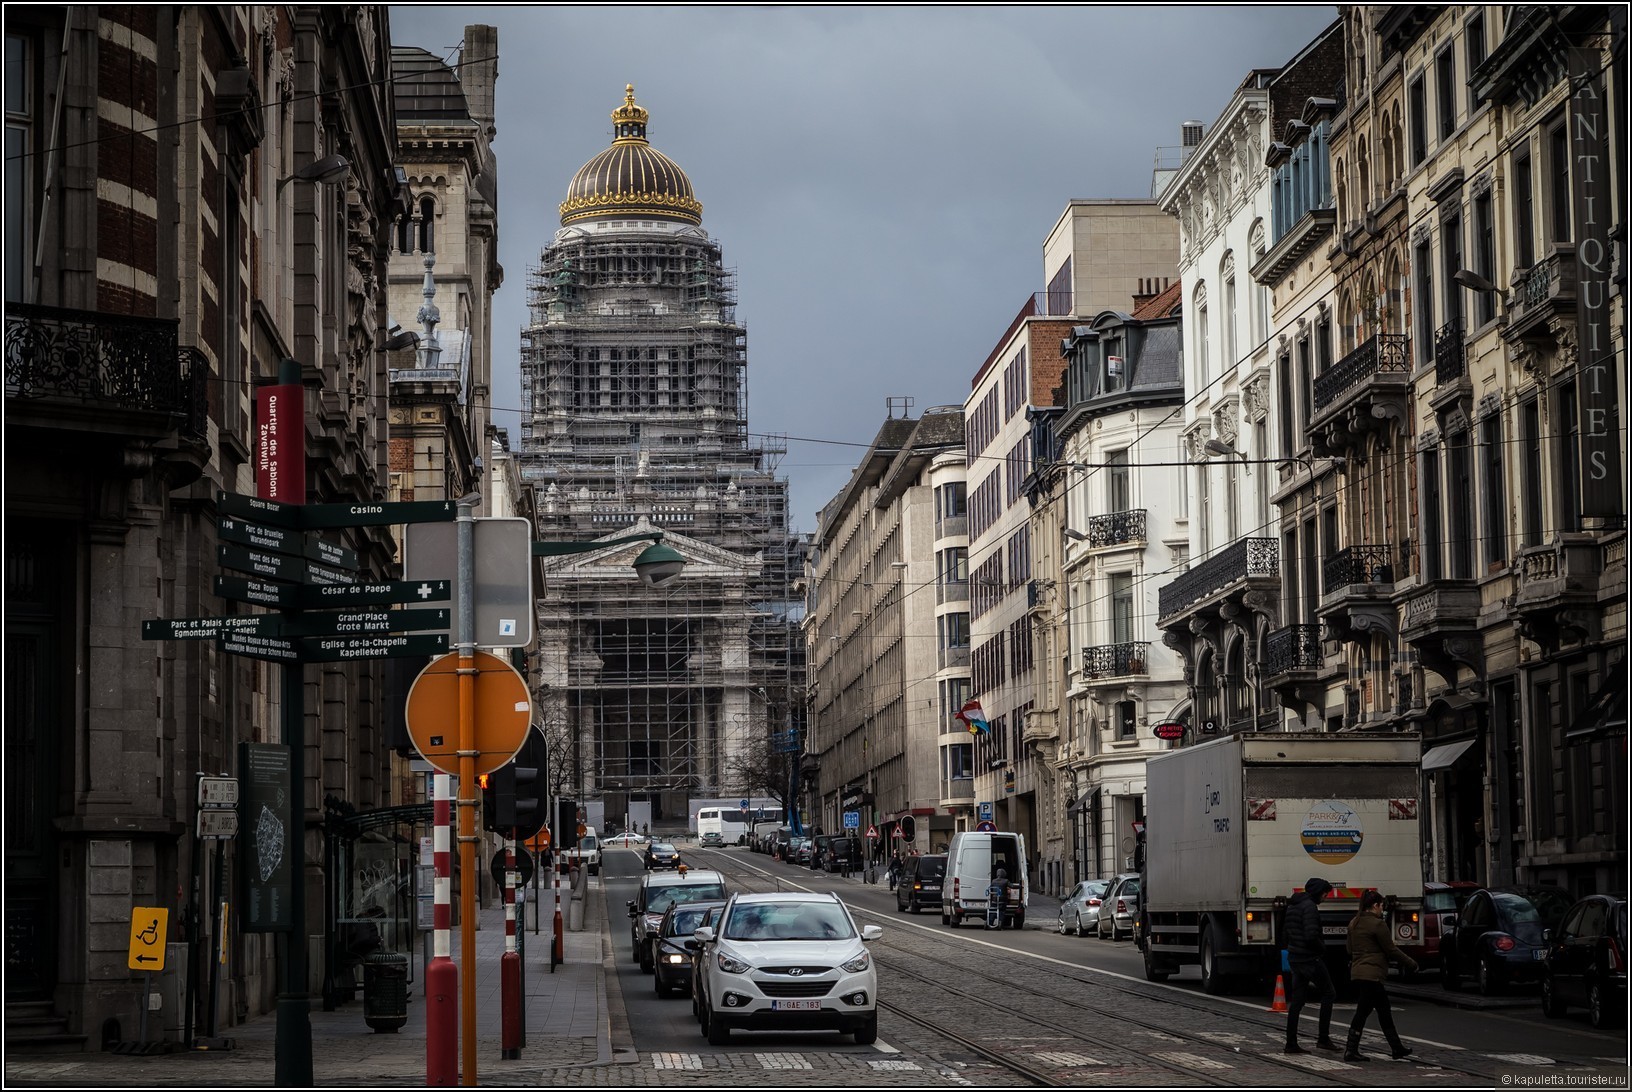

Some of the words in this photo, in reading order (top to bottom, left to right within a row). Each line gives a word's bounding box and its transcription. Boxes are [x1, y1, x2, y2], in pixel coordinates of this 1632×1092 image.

[1574, 70, 1607, 481] ANTIQUITES
[269, 395, 277, 435] Quartier
[260, 424, 268, 471] Zavelwijk
[269, 439, 277, 456] des
[269, 461, 277, 498] Sablons
[249, 498, 265, 509] Square
[350, 505, 383, 514] Casino
[245, 524, 256, 534] Parc
[256, 527, 263, 535] de
[264, 528, 284, 540] Bruxelles
[250, 534, 280, 548] Warandepark
[249, 552, 261, 562] Mont
[261, 554, 270, 564] des
[270, 556, 281, 566] Arts
[253, 562, 277, 575] Kunstberg
[247, 581, 261, 591] Place
[263, 583, 279, 594] Royale
[321, 587, 346, 595] César
[349, 586, 361, 594] de
[364, 585, 391, 593] Paepe
[171, 621, 187, 629] Parc
[201, 619, 222, 628] Palais
[225, 617, 260, 627] d'Egmont
[338, 613, 388, 622] Grand'Place
[336, 623, 361, 631] Grote
[364, 621, 390, 630] Markt
[174, 628, 217, 639] Egmontpark
[261, 638, 270, 646] des
[321, 641, 345, 650] Eglise
[349, 637, 407, 648] de-la-Chapelle
[258, 647, 268, 655] voor
[267, 648, 282, 657] Schone
[282, 650, 298, 659] Kunsten
[339, 647, 388, 658] Kapellekerk
[982, 804, 990, 813] P
[1214, 818, 1230, 832] TRAFIC
[778, 1001, 820, 1009] 1-GAE-183
